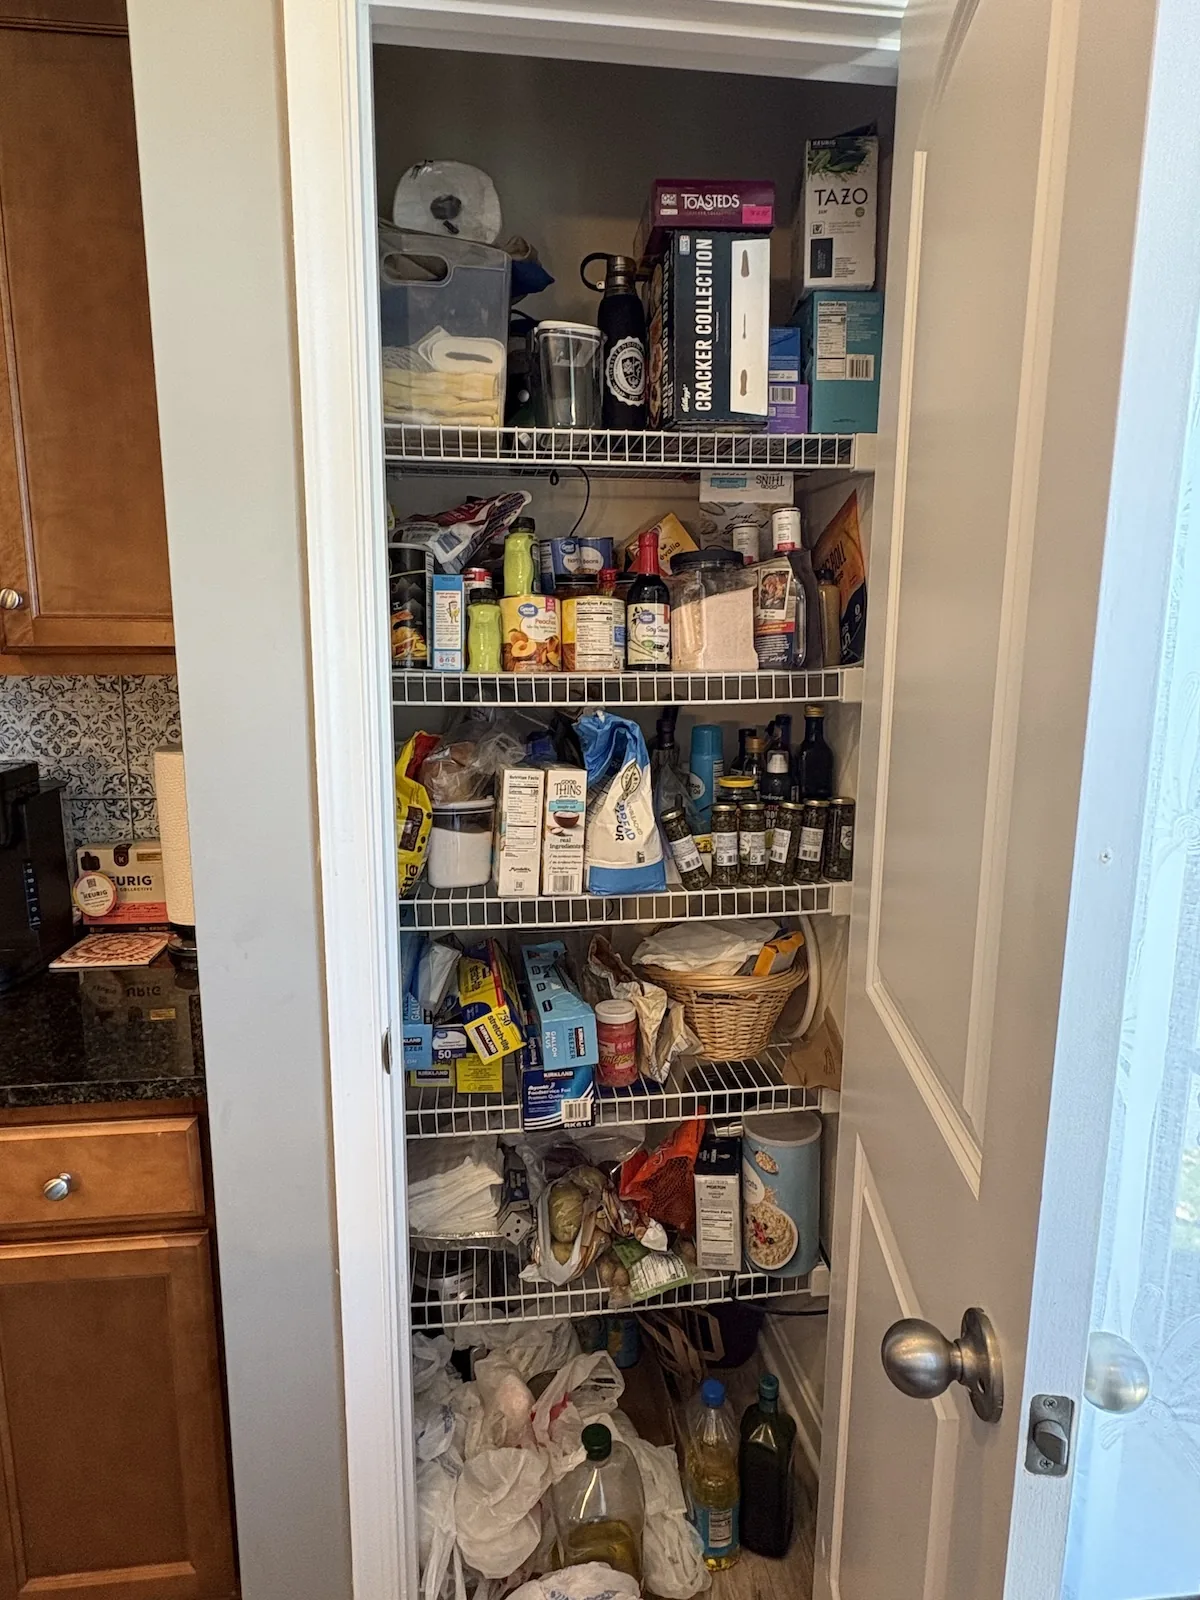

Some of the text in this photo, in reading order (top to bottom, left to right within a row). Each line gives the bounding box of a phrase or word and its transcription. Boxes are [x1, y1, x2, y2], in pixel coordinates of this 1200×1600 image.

[680, 193, 740, 211] TOASTEDS
[814, 187, 868, 206] TAZO
[662, 250, 670, 325] CRACKER
[695, 238, 713, 411] CRACKER COLLECTION
[662, 327, 670, 418] COLLECTION
[755, 475, 785, 487] THINS
[645, 625, 657, 635] Soy
[553, 782, 582, 796] THINS
[619, 804, 636, 841] BREAD
[83, 889, 108, 899] KEURIG
[502, 1009, 512, 1027] 750
[478, 1025, 497, 1054] KIRKLAND
[487, 1014, 510, 1051] stretch-tite
[544, 1031, 552, 1050] PLUS
[550, 1031, 558, 1058] GALLON
[568, 1028, 576, 1060] FREEZER
[438, 1050, 452, 1059] 50
